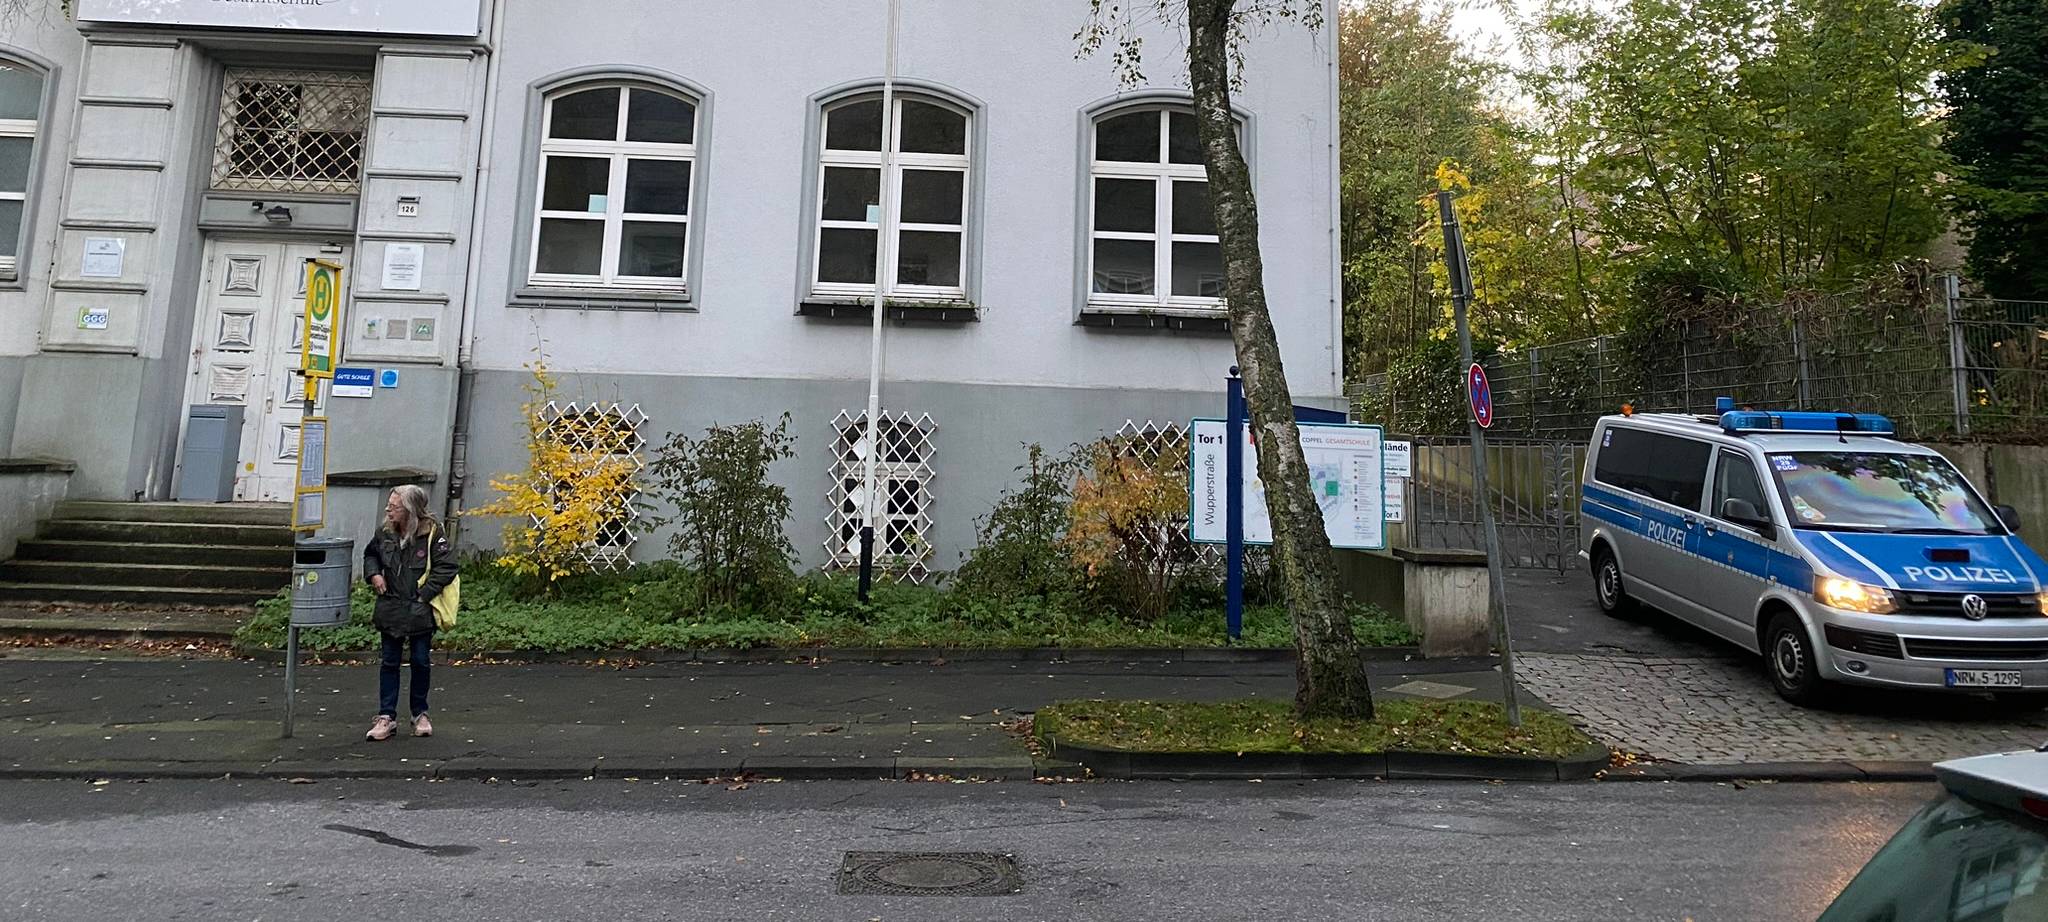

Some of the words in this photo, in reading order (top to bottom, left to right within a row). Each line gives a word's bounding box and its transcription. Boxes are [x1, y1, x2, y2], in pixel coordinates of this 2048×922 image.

[402, 205, 415, 213] 126
[315, 278, 327, 310] H
[83, 315, 106, 323] GGG
[1198, 434, 1214, 444] Tor
[1218, 435, 1223, 444] 1
[1326, 438, 1370, 446] GESAMTSCHULE
[1384, 443, 1408, 452] lände
[1205, 453, 1217, 525] Wupperstraße
[1647, 519, 1687, 550] POLIZEI
[1903, 566, 2018, 584] POLIZEI
[1954, 670, 1976, 684] NRW
